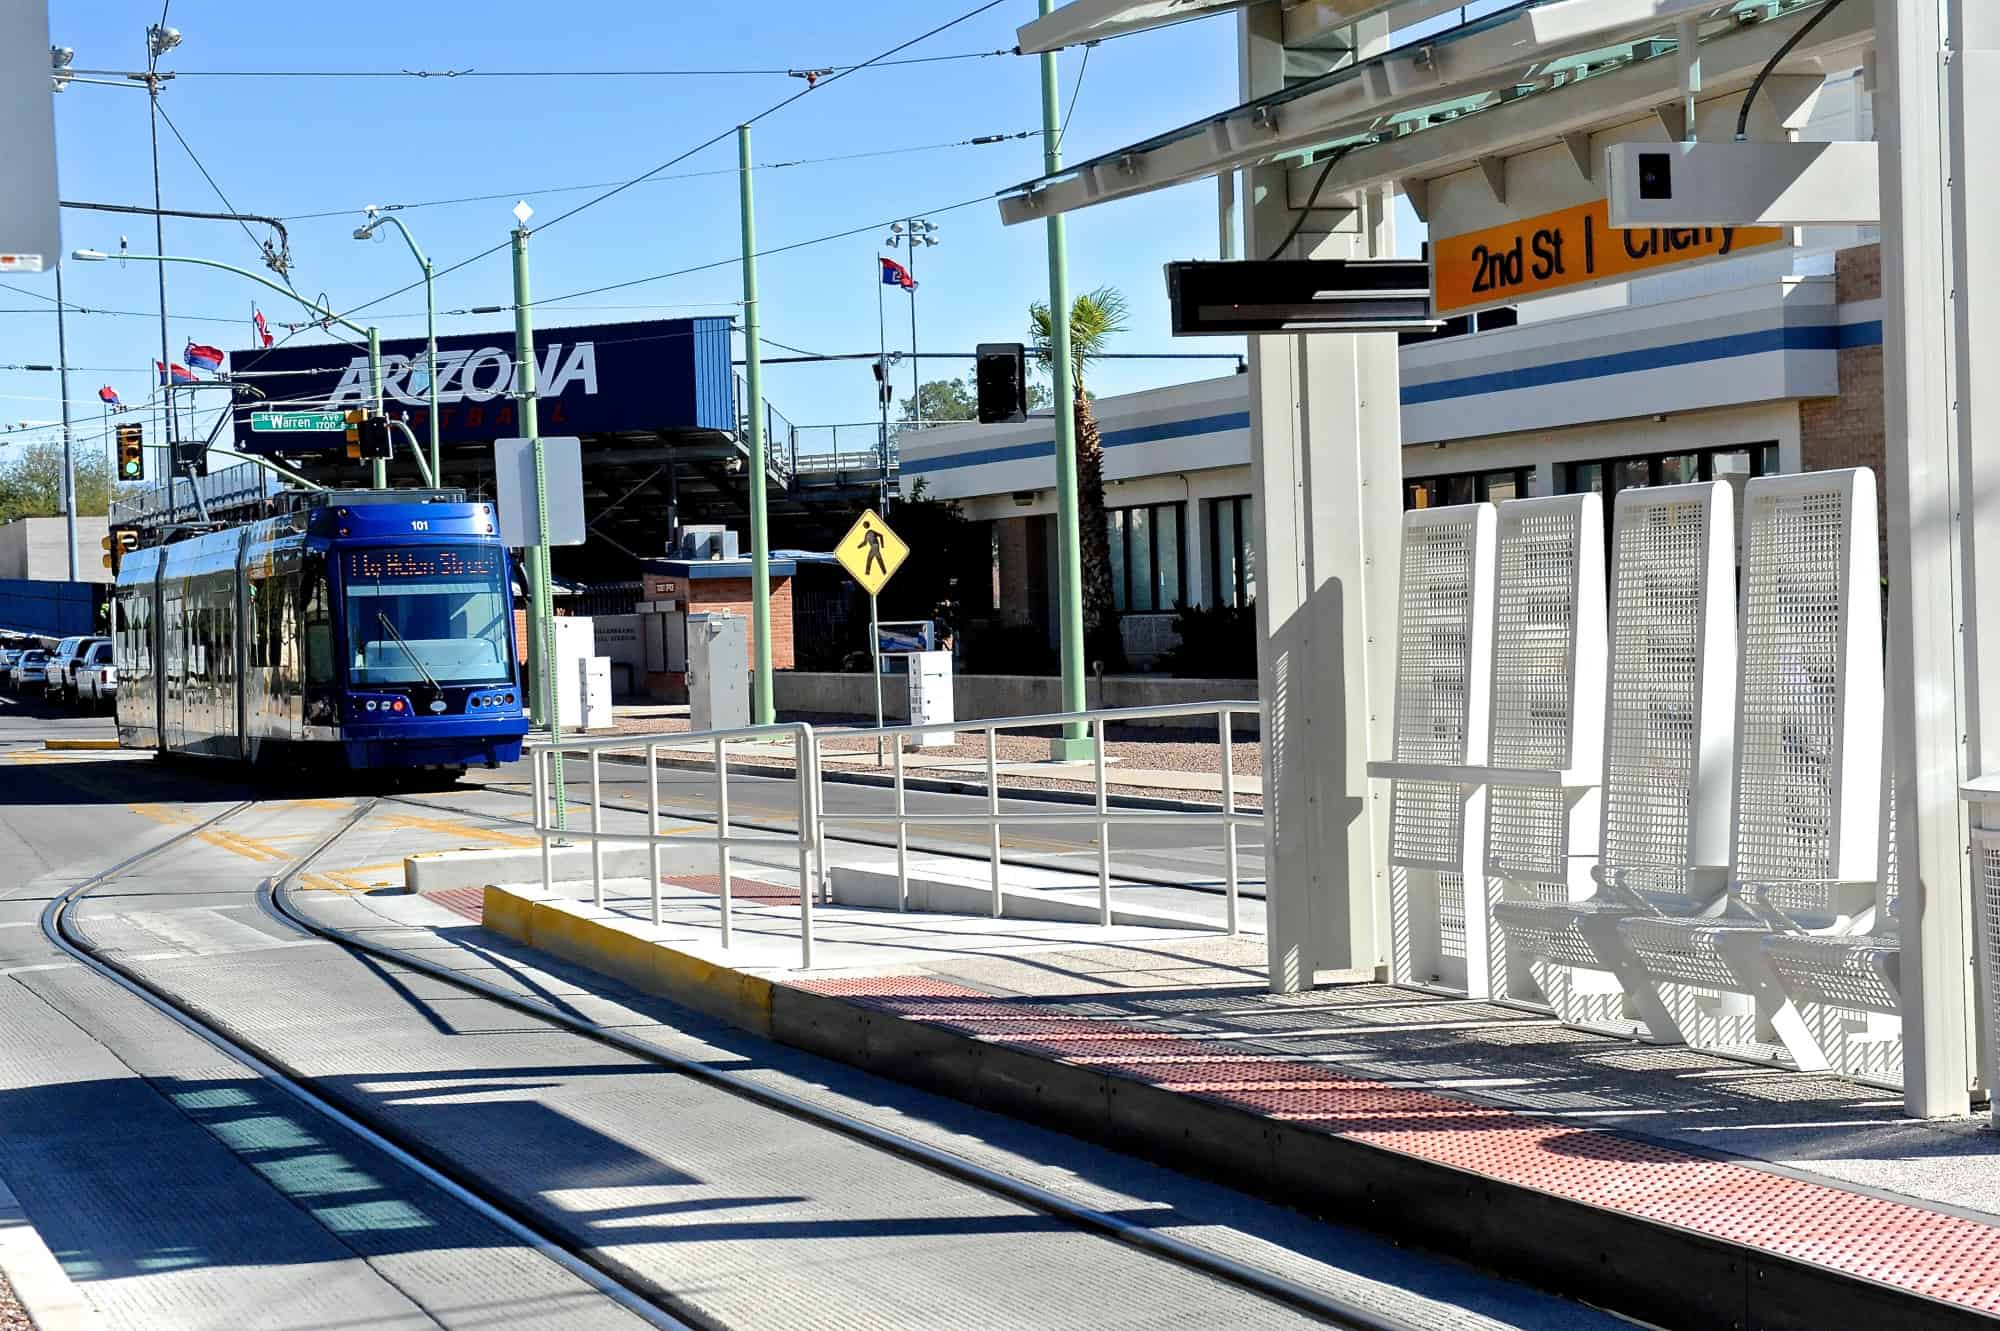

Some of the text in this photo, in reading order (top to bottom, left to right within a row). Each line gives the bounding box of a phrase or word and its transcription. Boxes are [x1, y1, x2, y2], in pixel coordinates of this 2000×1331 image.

[1471, 236, 1523, 293] 2nd
[1531, 228, 1565, 280] St
[328, 341, 598, 408] ARIZONA
[271, 414, 311, 429] Warren
[322, 413, 339, 422] Ave
[315, 421, 337, 429] 1700
[411, 520, 429, 531] 101
